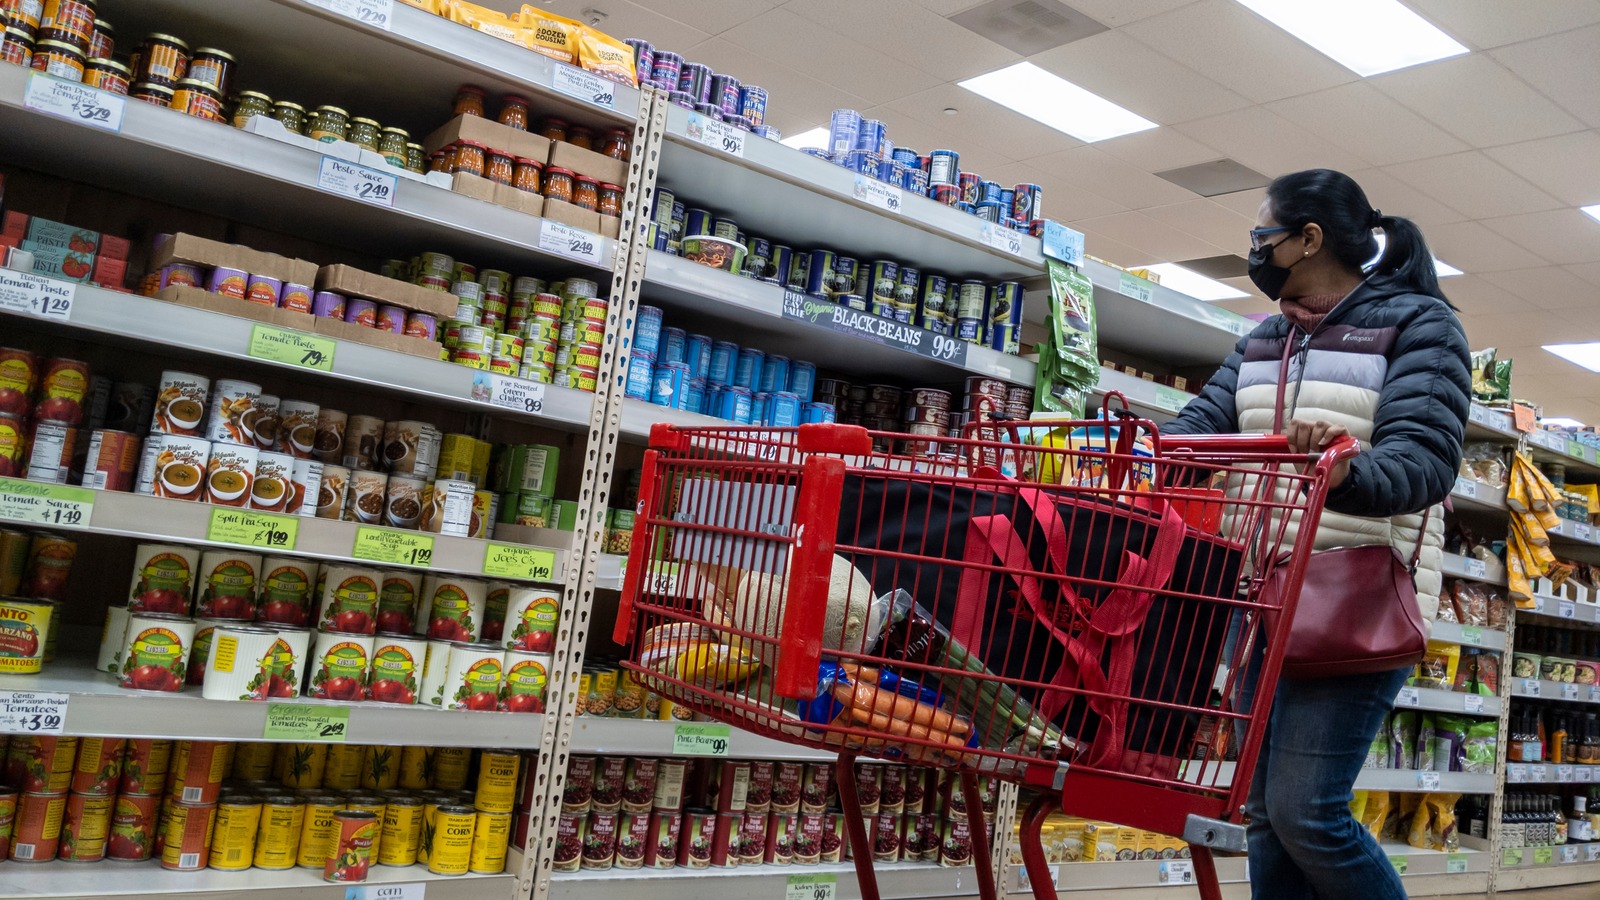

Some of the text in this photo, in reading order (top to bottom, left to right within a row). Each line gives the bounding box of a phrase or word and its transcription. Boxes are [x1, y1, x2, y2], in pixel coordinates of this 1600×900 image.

[535, 33, 566, 46] COUSINS
[541, 28, 566, 40] DOZEN
[51, 88, 100, 106] Tomatoes
[54, 82, 71, 91] Sun
[74, 87, 98, 100] Dried
[706, 125, 742, 143] Black Beans
[332, 161, 355, 175] Pesto
[358, 170, 383, 183] Sauce
[1008, 240, 1021, 253] 99
[20, 273, 50, 285] Italian
[0, 275, 71, 297] Tomato Paste
[785, 291, 806, 302] EVERY
[784, 299, 800, 309] DAY
[783, 305, 805, 319] VALUE
[804, 301, 962, 359] Organic BLACK BEANS 99¢
[261, 332, 290, 345] Tomato
[291, 338, 315, 349] Paste
[630, 367, 650, 375] BLAC
[503, 387, 526, 397] Green
[512, 382, 538, 392] Roasted
[175, 451, 190, 461] Split
[220, 457, 234, 467] Split
[1133, 462, 1151, 475] ORNGE
[0, 480, 50, 497] Organic
[2, 493, 80, 511] Tomato Sauce
[217, 513, 238, 525] Split
[241, 516, 255, 526] Pea
[256, 519, 279, 530] Soup
[384, 537, 418, 547] Vegetable
[0, 607, 28, 622] NTO
[0, 626, 33, 642] ARZANO
[0, 658, 34, 667] MATOES
[5, 704, 58, 713] Tomatoes
[271, 704, 311, 715] Organic
[271, 720, 308, 728] Tomatoes
[677, 734, 692, 743] Pinto
[490, 768, 514, 777] CORN
[446, 827, 472, 836] CORN
[794, 883, 813, 891] Kidney
